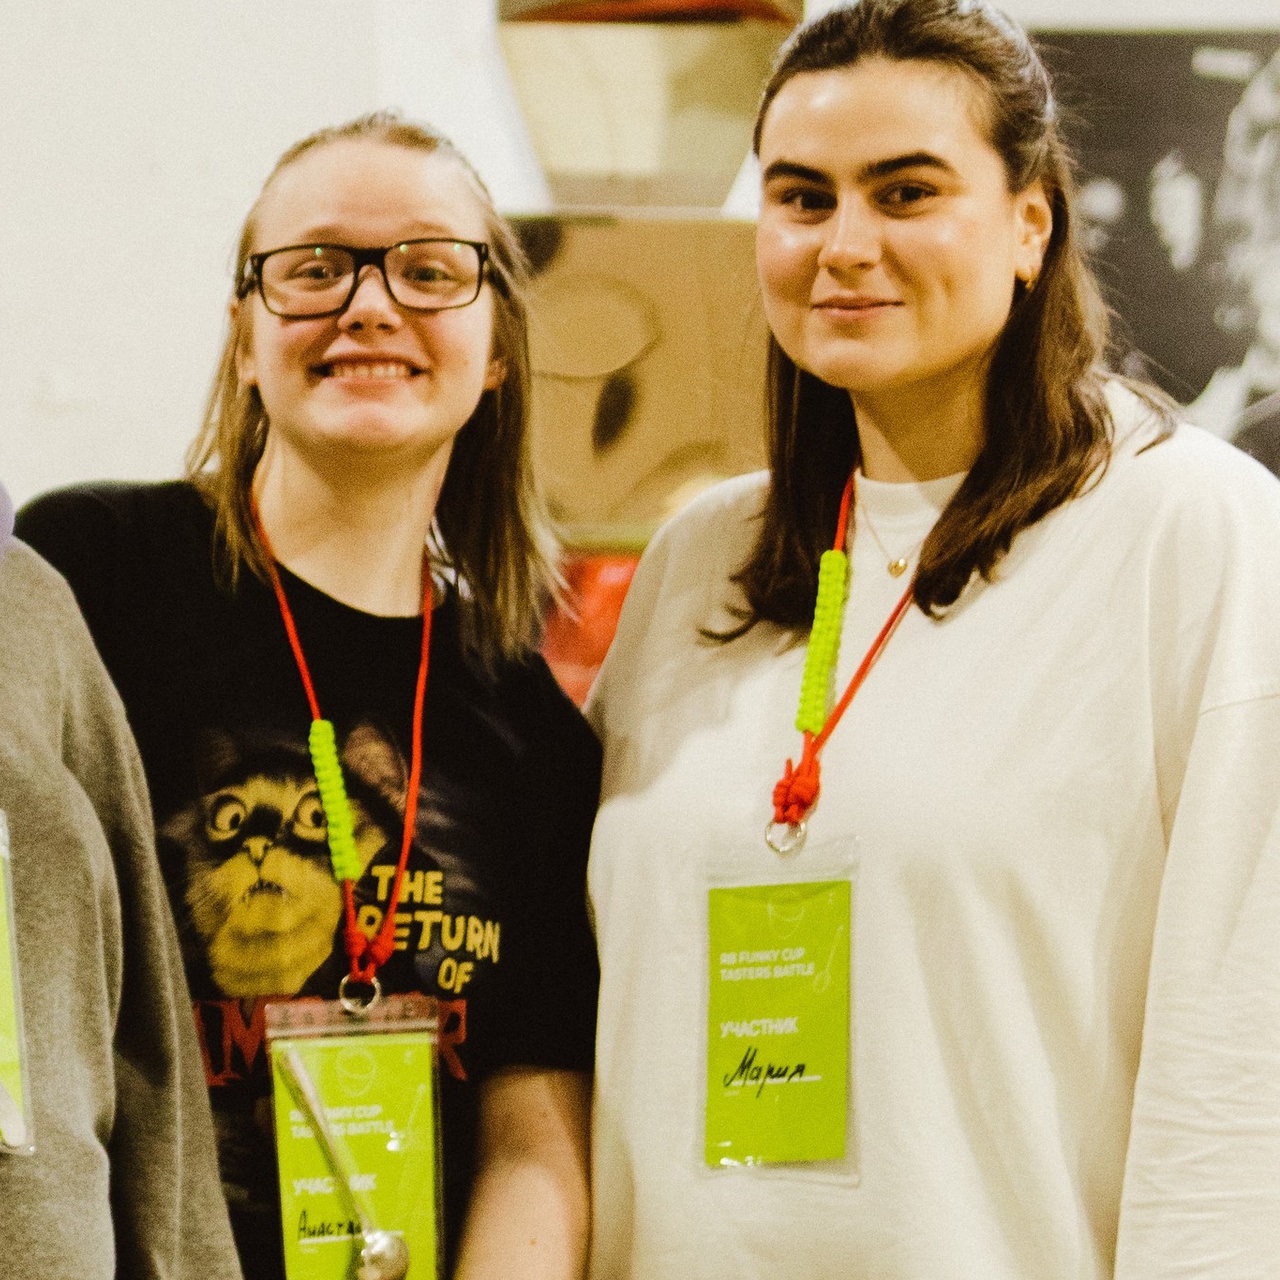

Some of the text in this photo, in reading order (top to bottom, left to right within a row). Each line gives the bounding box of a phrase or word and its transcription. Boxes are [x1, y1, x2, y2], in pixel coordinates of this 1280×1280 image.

[371, 864, 444, 905] THE
[781, 947, 806, 961] CUP
[437, 957, 474, 994] OF
[720, 1016, 799, 1039] УЧАСТНИК
[723, 1045, 806, 1099] Мария
